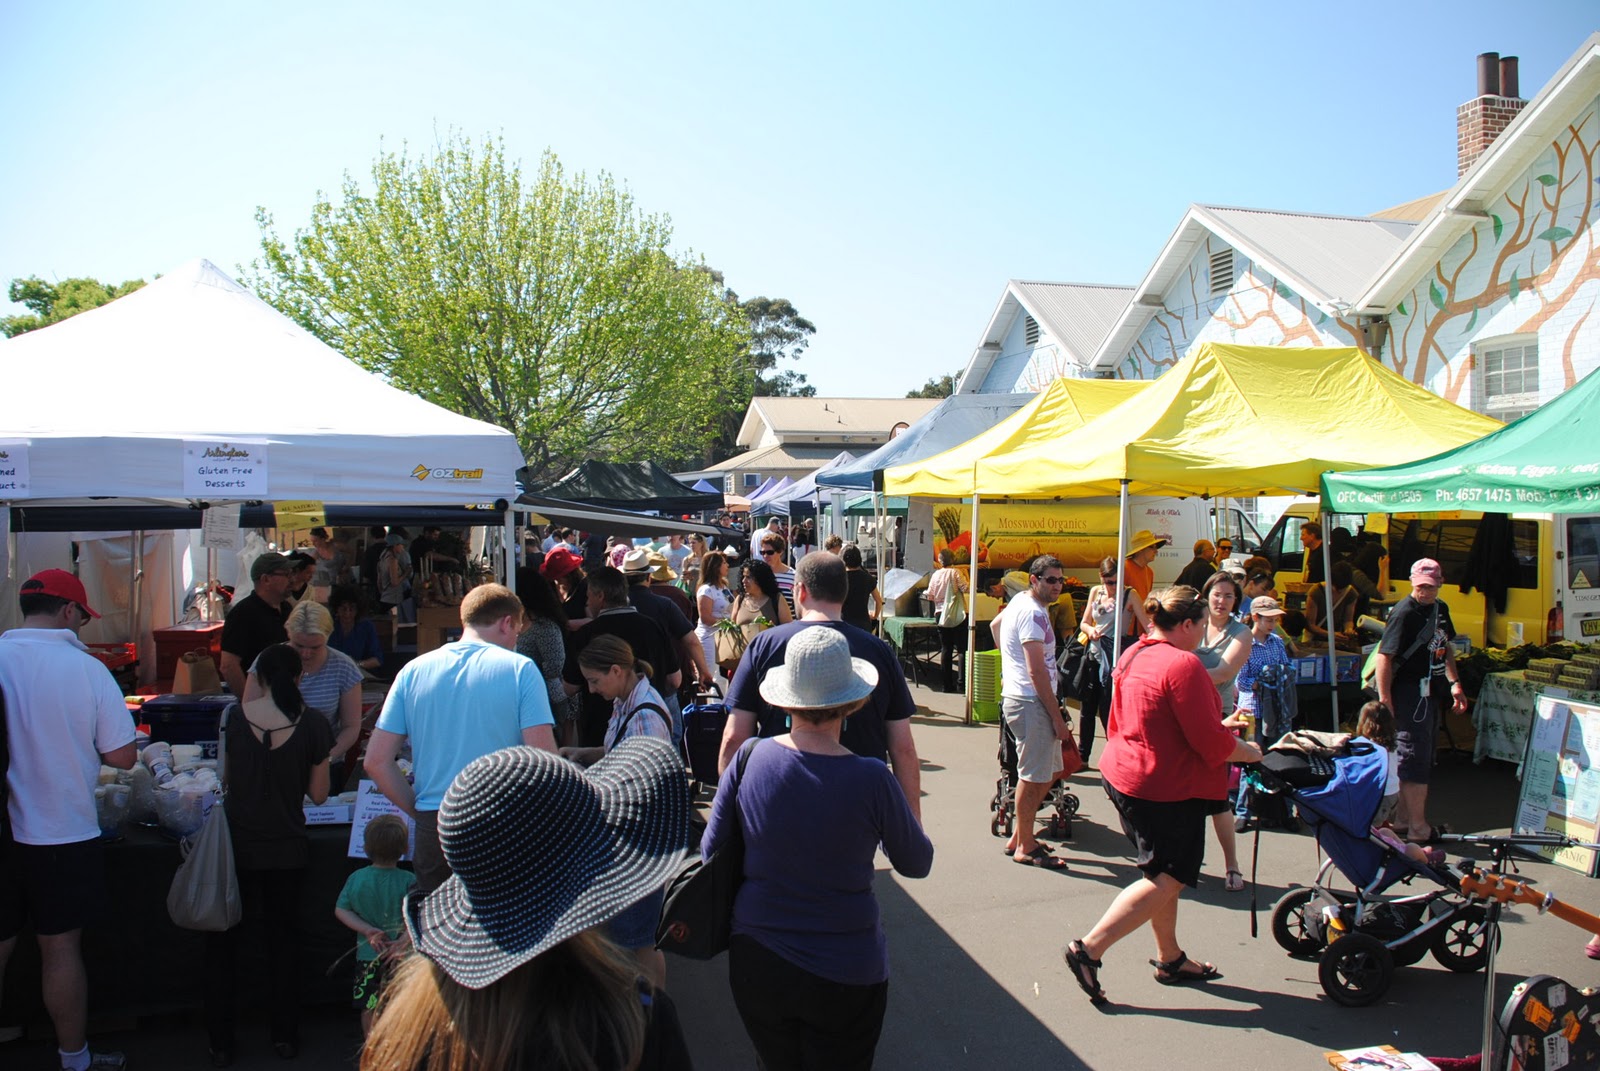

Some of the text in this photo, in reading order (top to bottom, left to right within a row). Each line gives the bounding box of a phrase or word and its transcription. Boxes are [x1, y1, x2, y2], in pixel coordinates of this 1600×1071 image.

[198, 466, 253, 475] Gluten Free
[432, 468, 484, 479] OZtrail
[205, 480, 246, 488] Desserts
[1337, 491, 1356, 503] OFC
[1436, 489, 1454, 501] Ph:
[1456, 488, 1482, 501] 4657
[1485, 488, 1512, 502] 1475
[999, 517, 1087, 532] Mosswood Organics
[1542, 844, 1588, 864] ORGANIC
